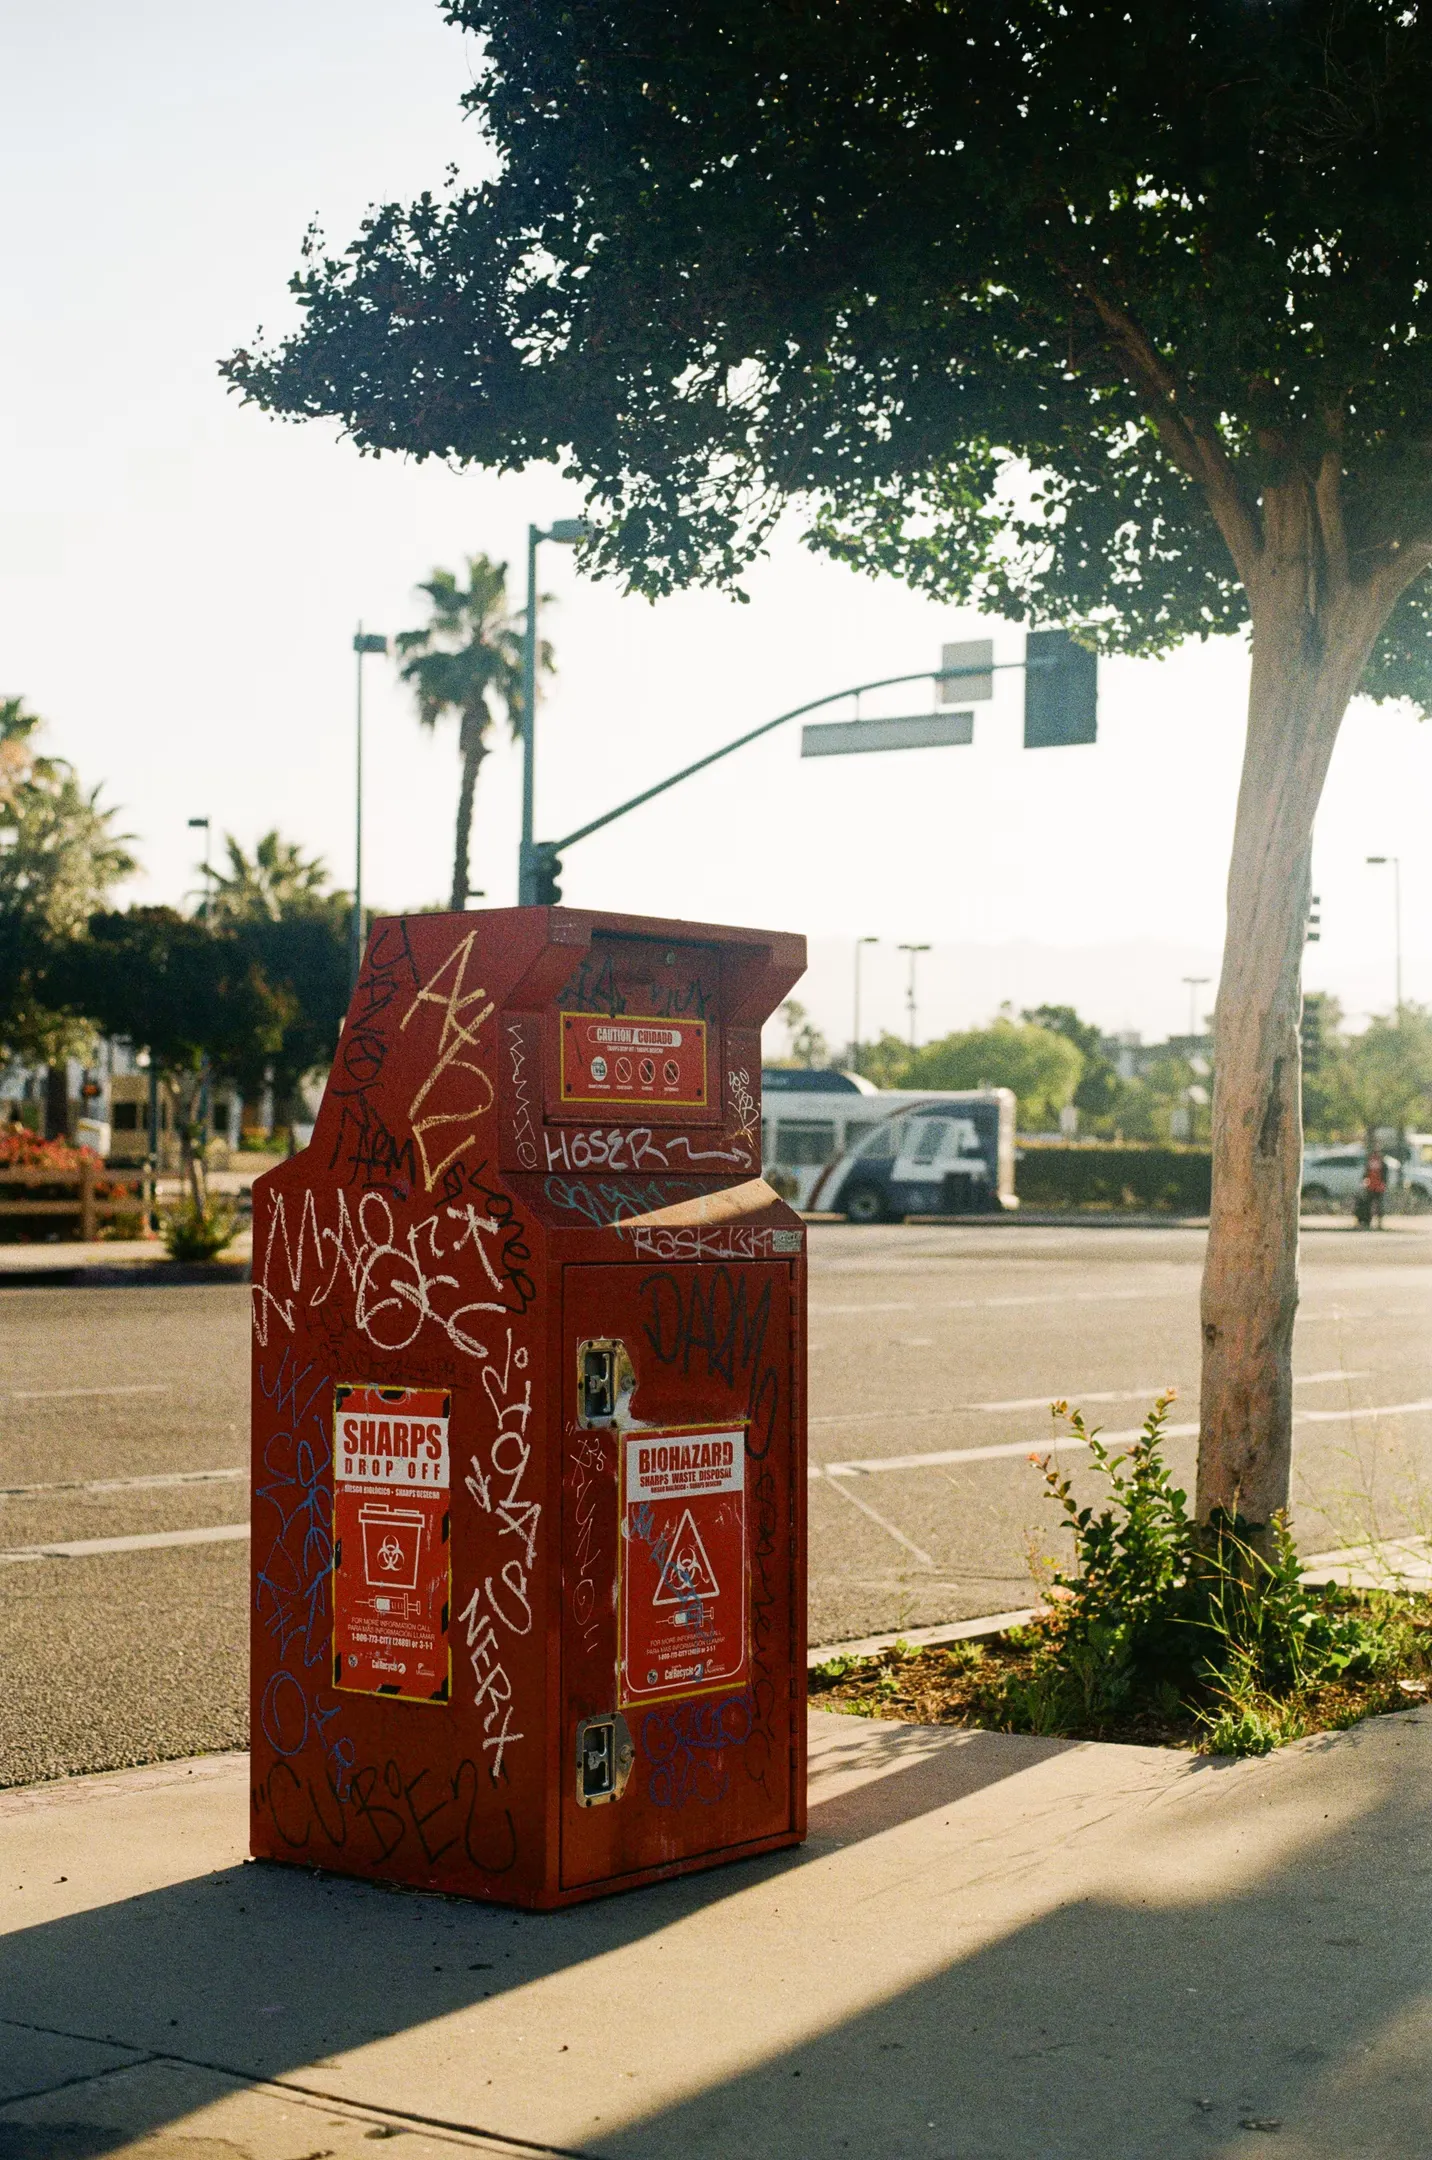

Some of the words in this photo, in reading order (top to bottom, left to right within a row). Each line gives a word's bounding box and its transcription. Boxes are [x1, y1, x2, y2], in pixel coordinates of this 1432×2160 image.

[596, 1028, 632, 1043] CAUTION
[638, 1030, 673, 1045] CUIDADO
[343, 1419, 442, 1460] SHARPS
[638, 1441, 734, 1474] BIOHAZARD
[344, 1457, 394, 1477] DROP
[408, 1461, 440, 1480] OFF
[640, 1473, 669, 1487] SHARPS
[672, 1471, 697, 1483] WASTE
[699, 1467, 732, 1482] DISPOSAL
[347, 1624, 362, 1632] PARA
[413, 1631, 436, 1641] LLAMAR
[351, 1617, 363, 1625] FOR
[363, 1618, 380, 1627] MORE
[380, 1619, 417, 1631] INFORMATION
[417, 1624, 431, 1633] CALL
[419, 1640, 433, 1650] 3-1-1
